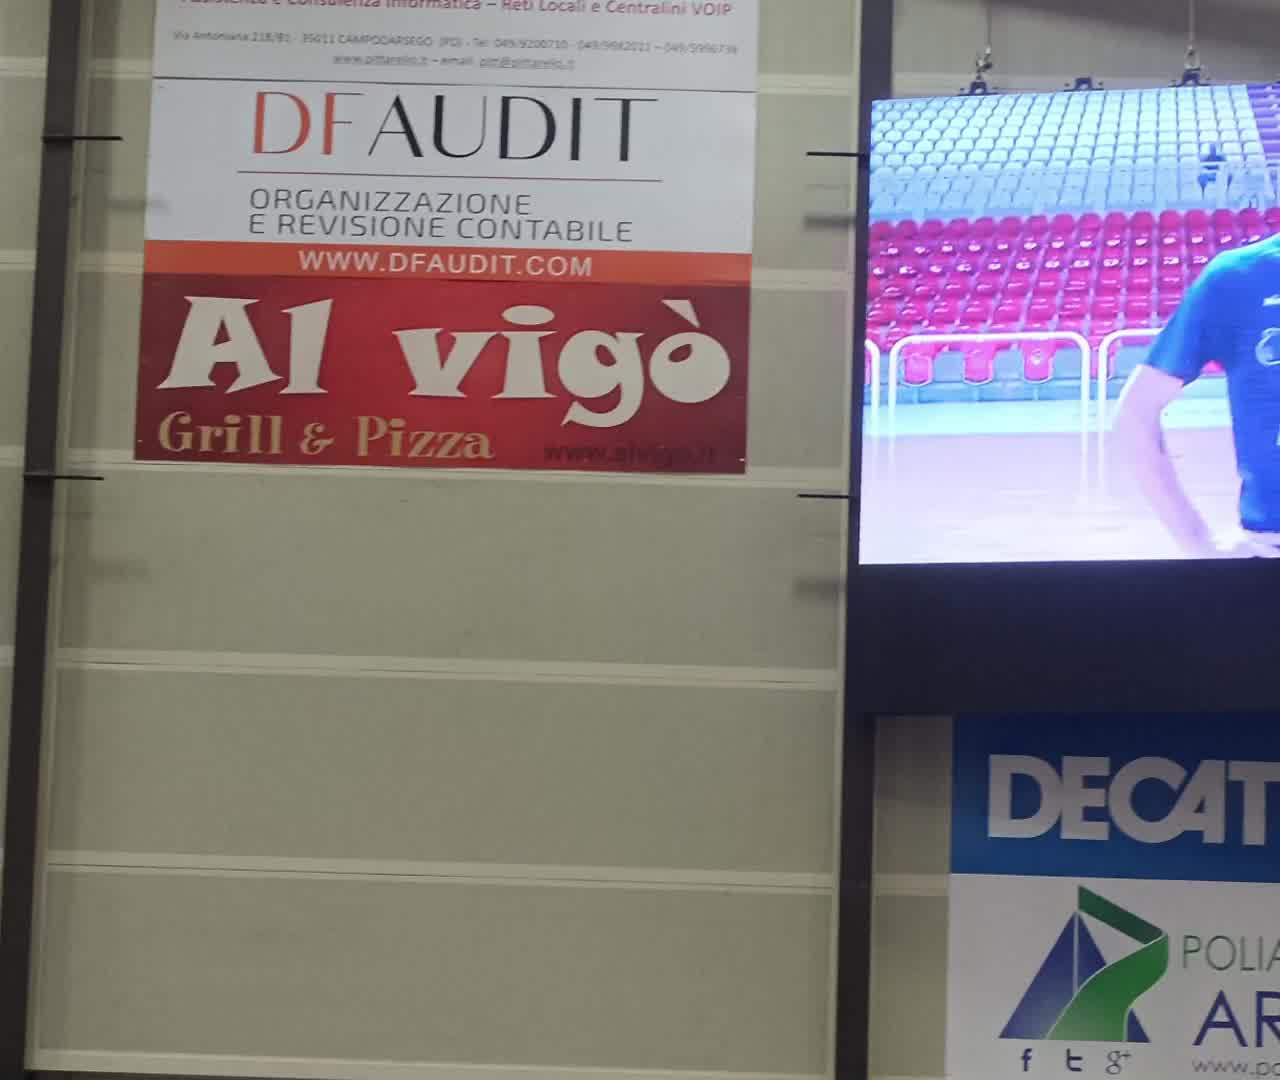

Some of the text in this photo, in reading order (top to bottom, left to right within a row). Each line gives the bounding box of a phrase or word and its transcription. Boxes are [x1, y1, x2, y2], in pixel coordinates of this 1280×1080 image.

[591, 4, 601, 12] e
[249, 187, 532, 216] ORGANIZZAZIONE
[249, 213, 633, 243] E REVISIONE CONTABILE
[298, 249, 592, 278] WWW.DFAUDIT.COM
[156, 295, 731, 428] Al vigò
[157, 411, 496, 459] Grill & Pizza
